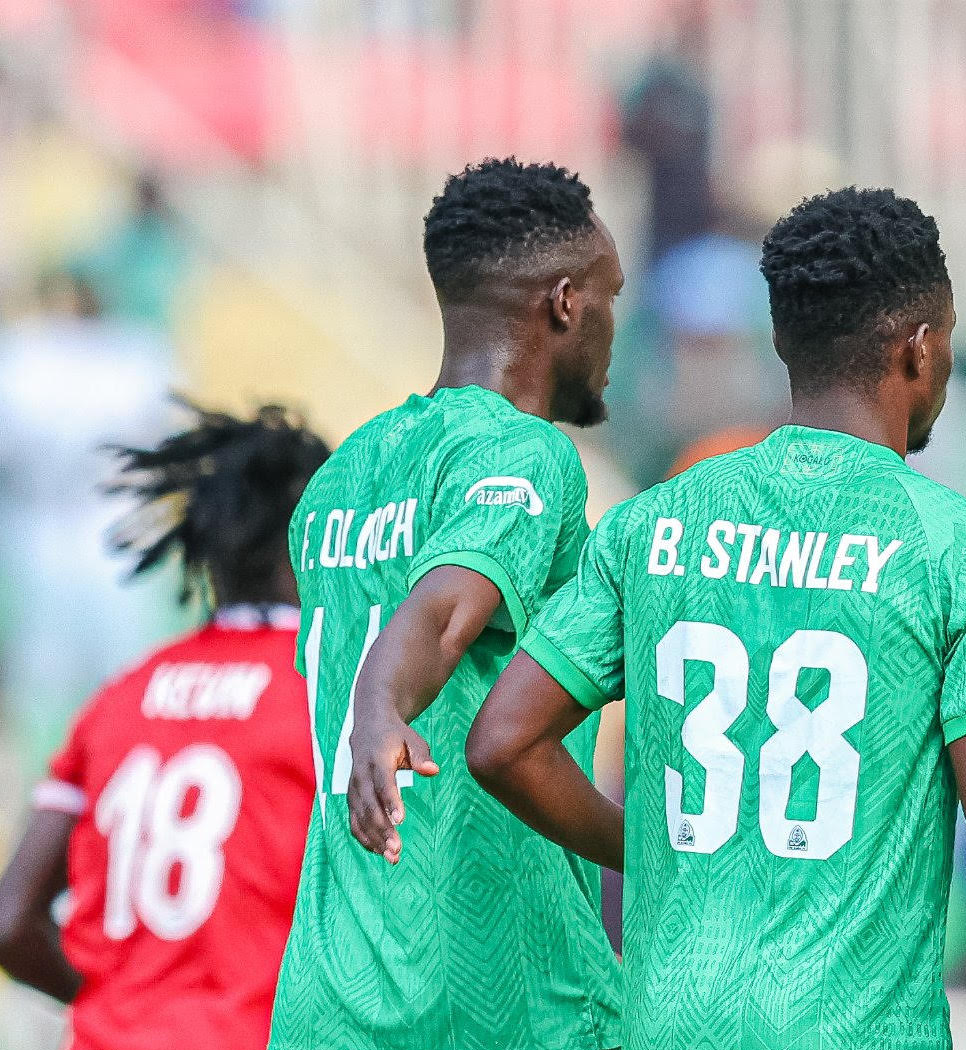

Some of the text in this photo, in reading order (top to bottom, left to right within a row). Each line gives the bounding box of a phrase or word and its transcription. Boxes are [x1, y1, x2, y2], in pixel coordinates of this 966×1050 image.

[647, 517, 904, 594] B. STANLEY
[655, 620, 869, 861] 38
[94, 744, 243, 941] 18
